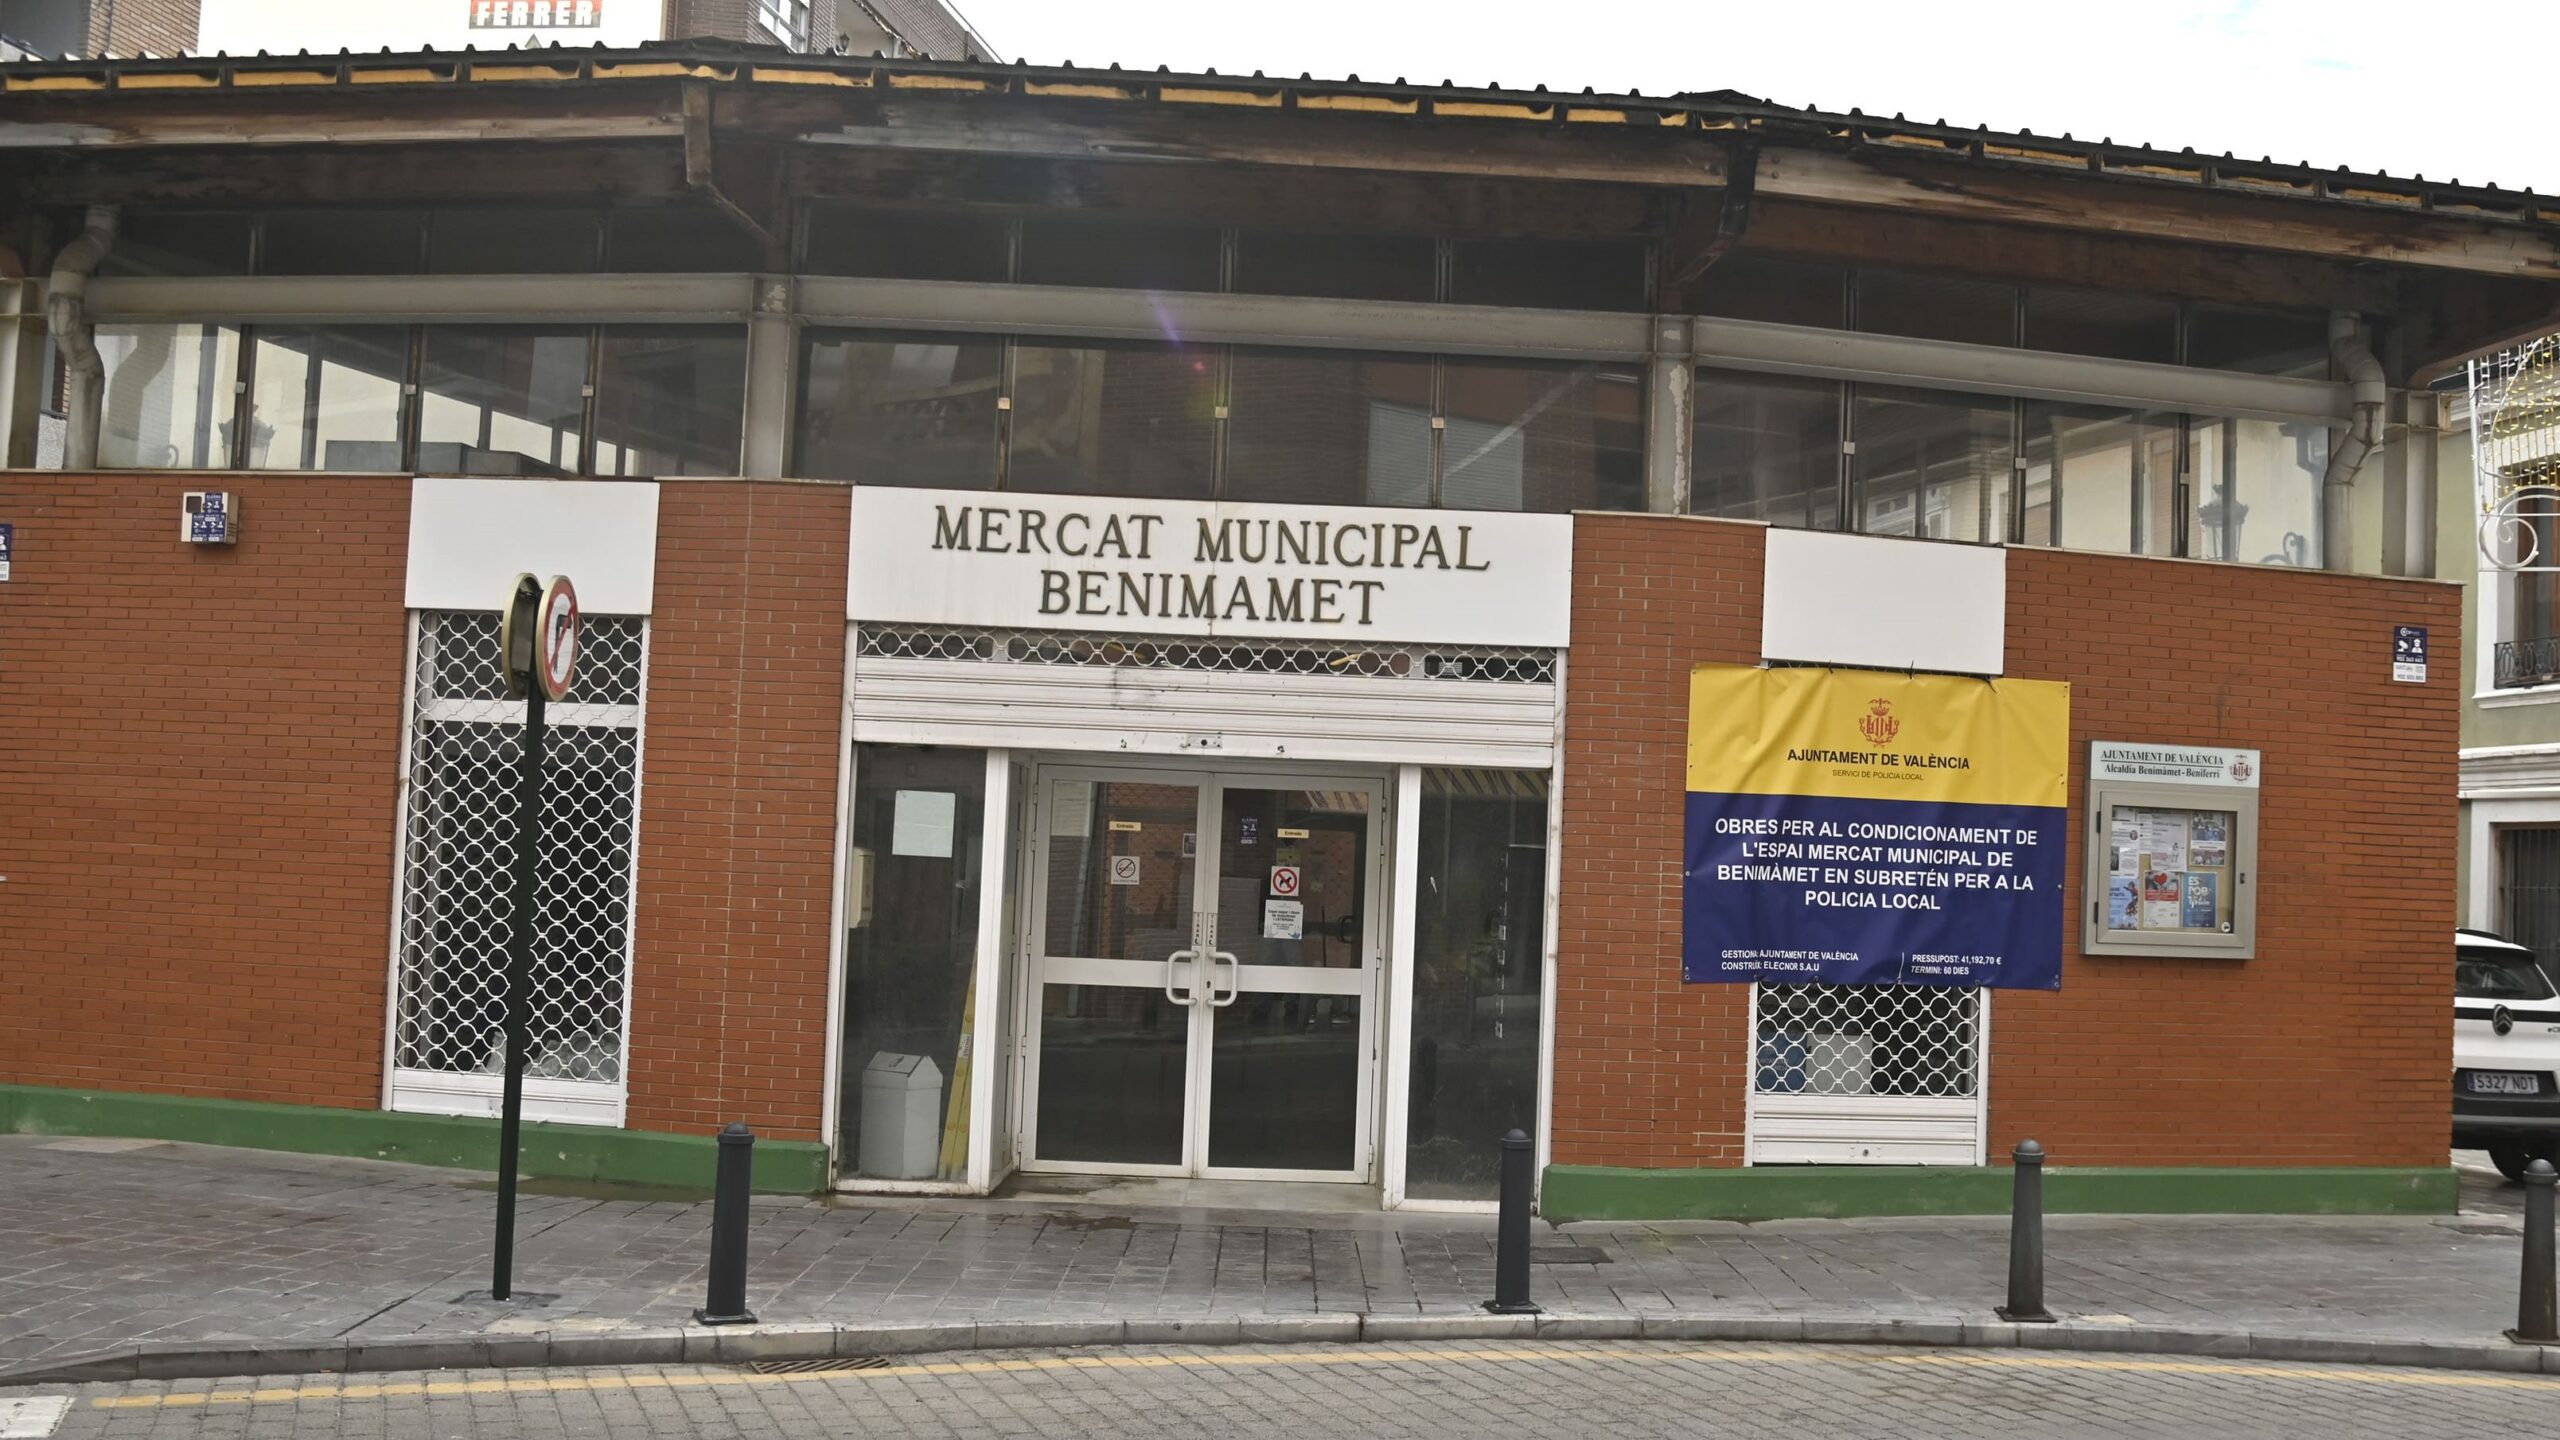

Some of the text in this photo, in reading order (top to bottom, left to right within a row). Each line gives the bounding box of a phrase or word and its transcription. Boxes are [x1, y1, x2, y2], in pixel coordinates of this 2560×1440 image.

[476, 0, 592, 26] FERRER
[932, 505, 1491, 571] MERCAT MUNICIPAL
[1037, 568, 1386, 625] BENIMAMET
[1787, 748, 1971, 770] AJUNTAMENT DE VALÈNCIA
[2101, 750, 2163, 762] AJUNTAMENT
[2164, 753, 2177, 763] DE
[1831, 769, 1860, 778] SERVICI
[1861, 771, 1871, 779] DE
[1901, 773, 1924, 781] LOCAL
[1715, 817, 2038, 846] OBRES PER AL CONDICIONAMENT DE
[1742, 842, 2013, 868] L'ESPAI MERCAT MUNICIPAL DE
[1717, 861, 2034, 891] BENIMÀMET EN SUBRETÉN PER A LA
[1805, 890, 1941, 911] POLICIA LOCAL
[1759, 949, 1807, 961] AJUNTAMENT
[1808, 951, 1819, 961] DE
[1763, 960, 1799, 971] ELECNOR
[1912, 954, 1959, 964] PRESSUPOST:
[1995, 956, 2002, 966] €
[1910, 965, 1970, 976] TERMINI: 60 DIES
